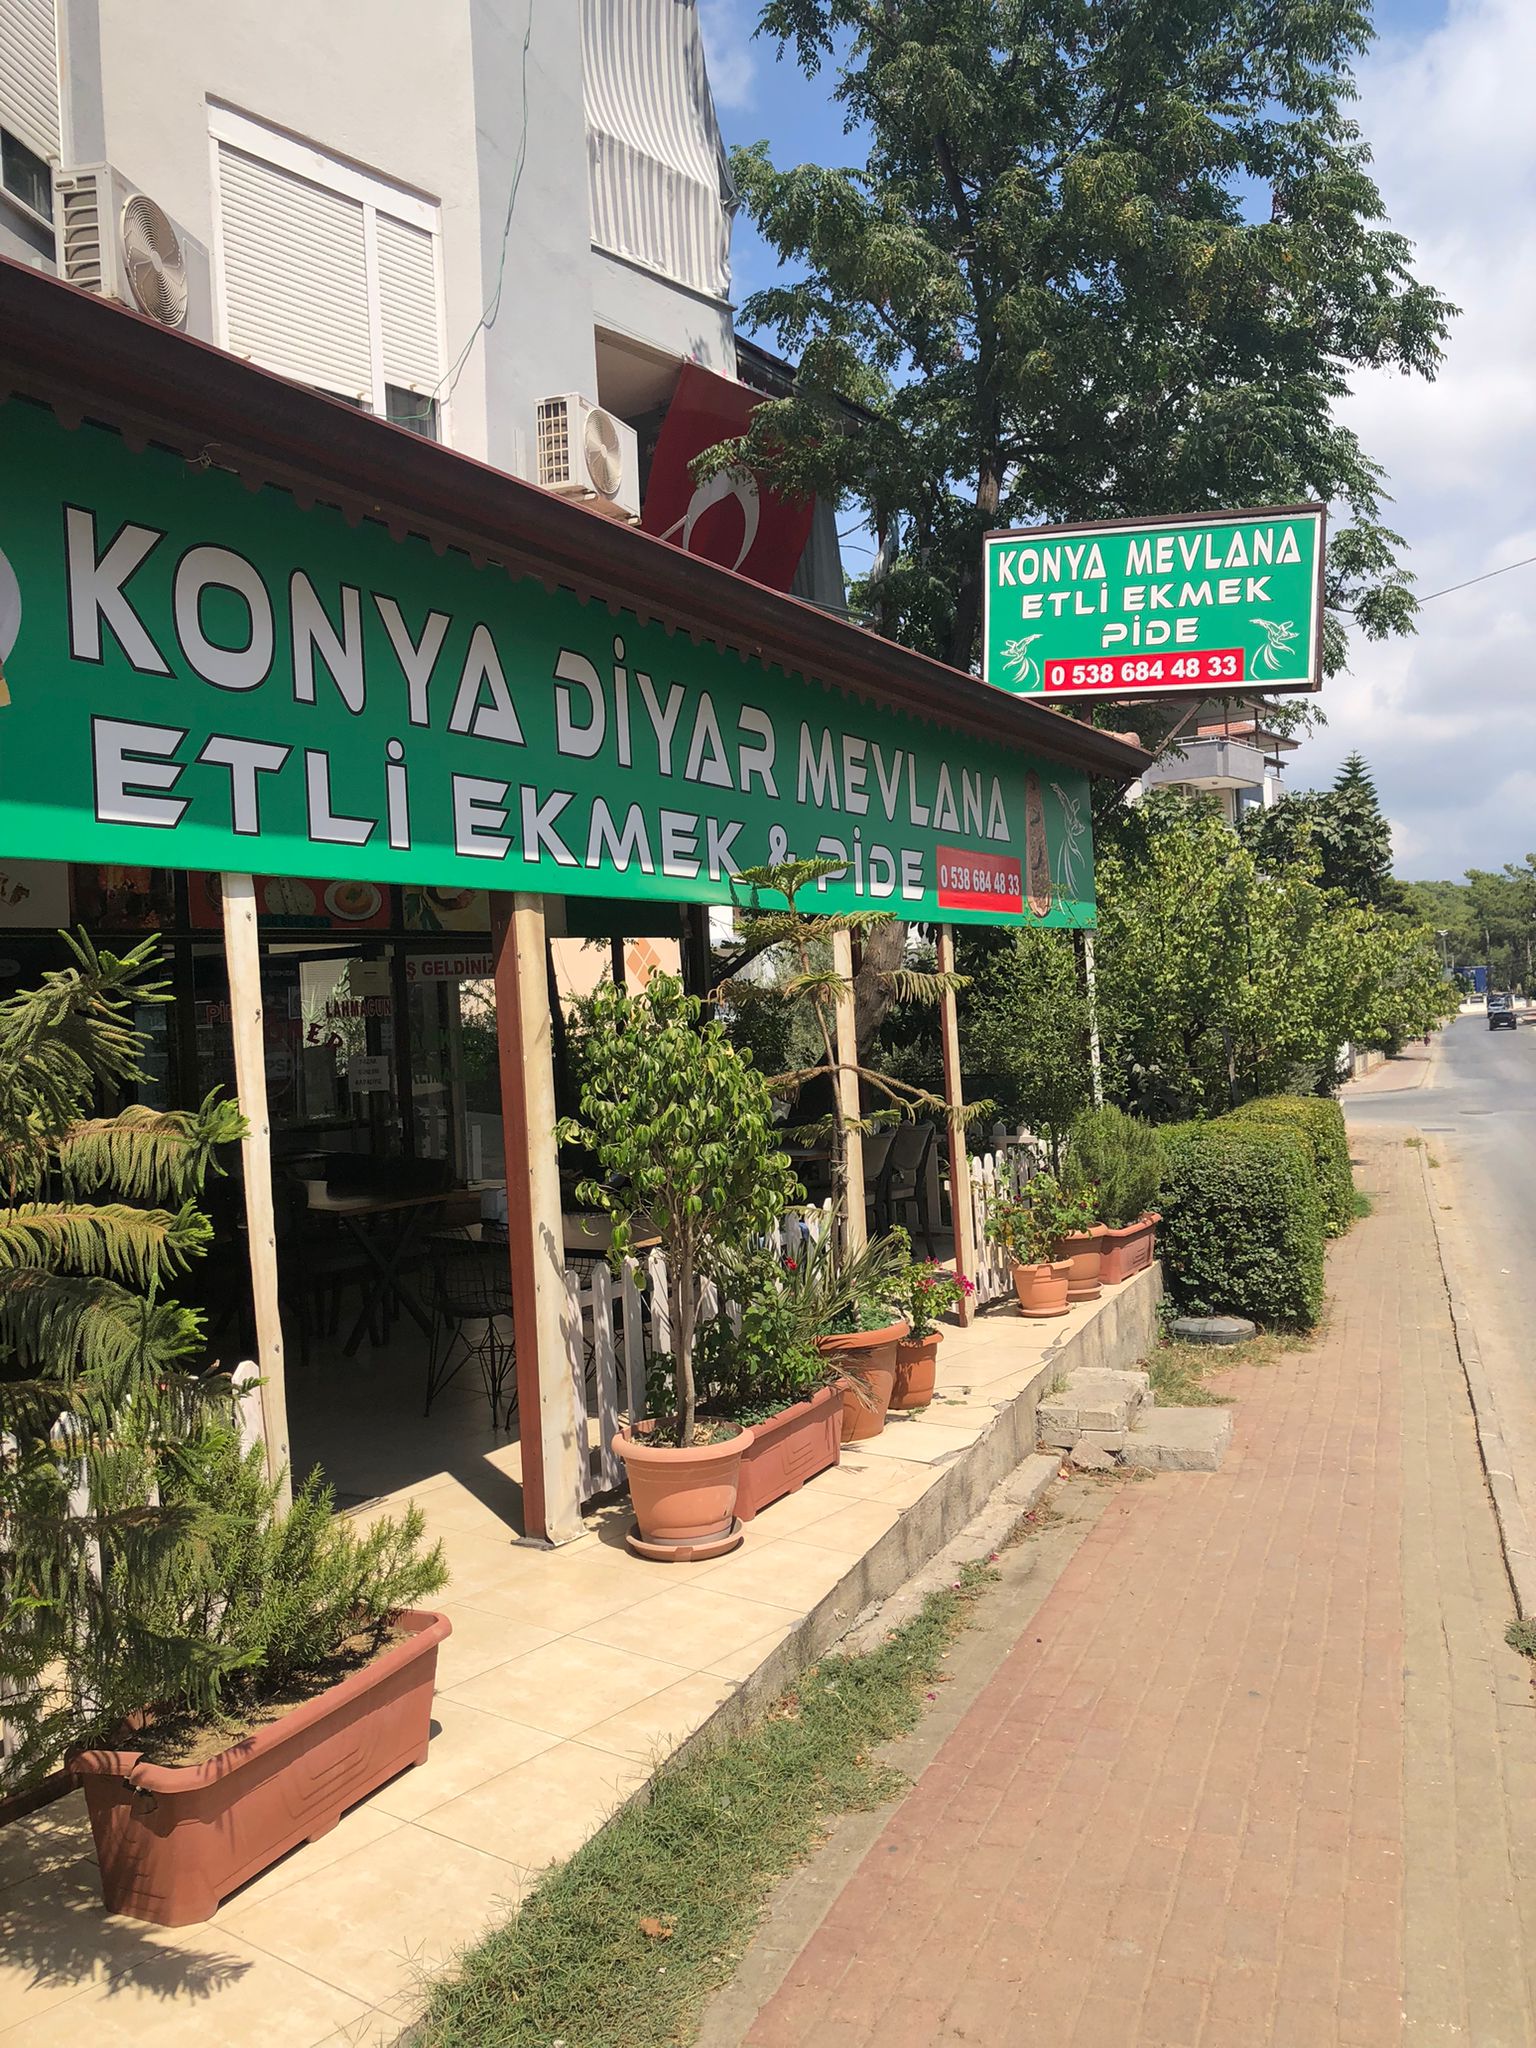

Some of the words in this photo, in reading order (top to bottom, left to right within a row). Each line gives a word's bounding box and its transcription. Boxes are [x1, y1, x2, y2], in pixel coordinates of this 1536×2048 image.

[998, 542, 1107, 587] KONYA
[1125, 526, 1302, 577] MEVLANA
[1021, 582, 1108, 619] ETLİ
[1123, 576, 1273, 611] EKMEK
[1102, 615, 1200, 648] PİDE
[63, 502, 527, 748] KONYA
[554, 635, 780, 800] DİYAR
[797, 721, 1012, 842] MEVLANA
[1051, 666, 1065, 686] 0
[1072, 661, 1114, 684] 538
[1121, 659, 1164, 682] 684
[1170, 657, 1201, 679] 48
[1208, 655, 1238, 676] 33
[90, 714, 412, 851] ETLİ
[451, 772, 750, 884] EKMEK
[768, 823, 797, 870] &
[816, 825, 926, 901] PİDE
[941, 865, 948, 888] 0
[951, 866, 970, 891] 538
[973, 869, 991, 893] 684
[994, 872, 1006, 894] 48
[1008, 874, 1020, 896] 33
